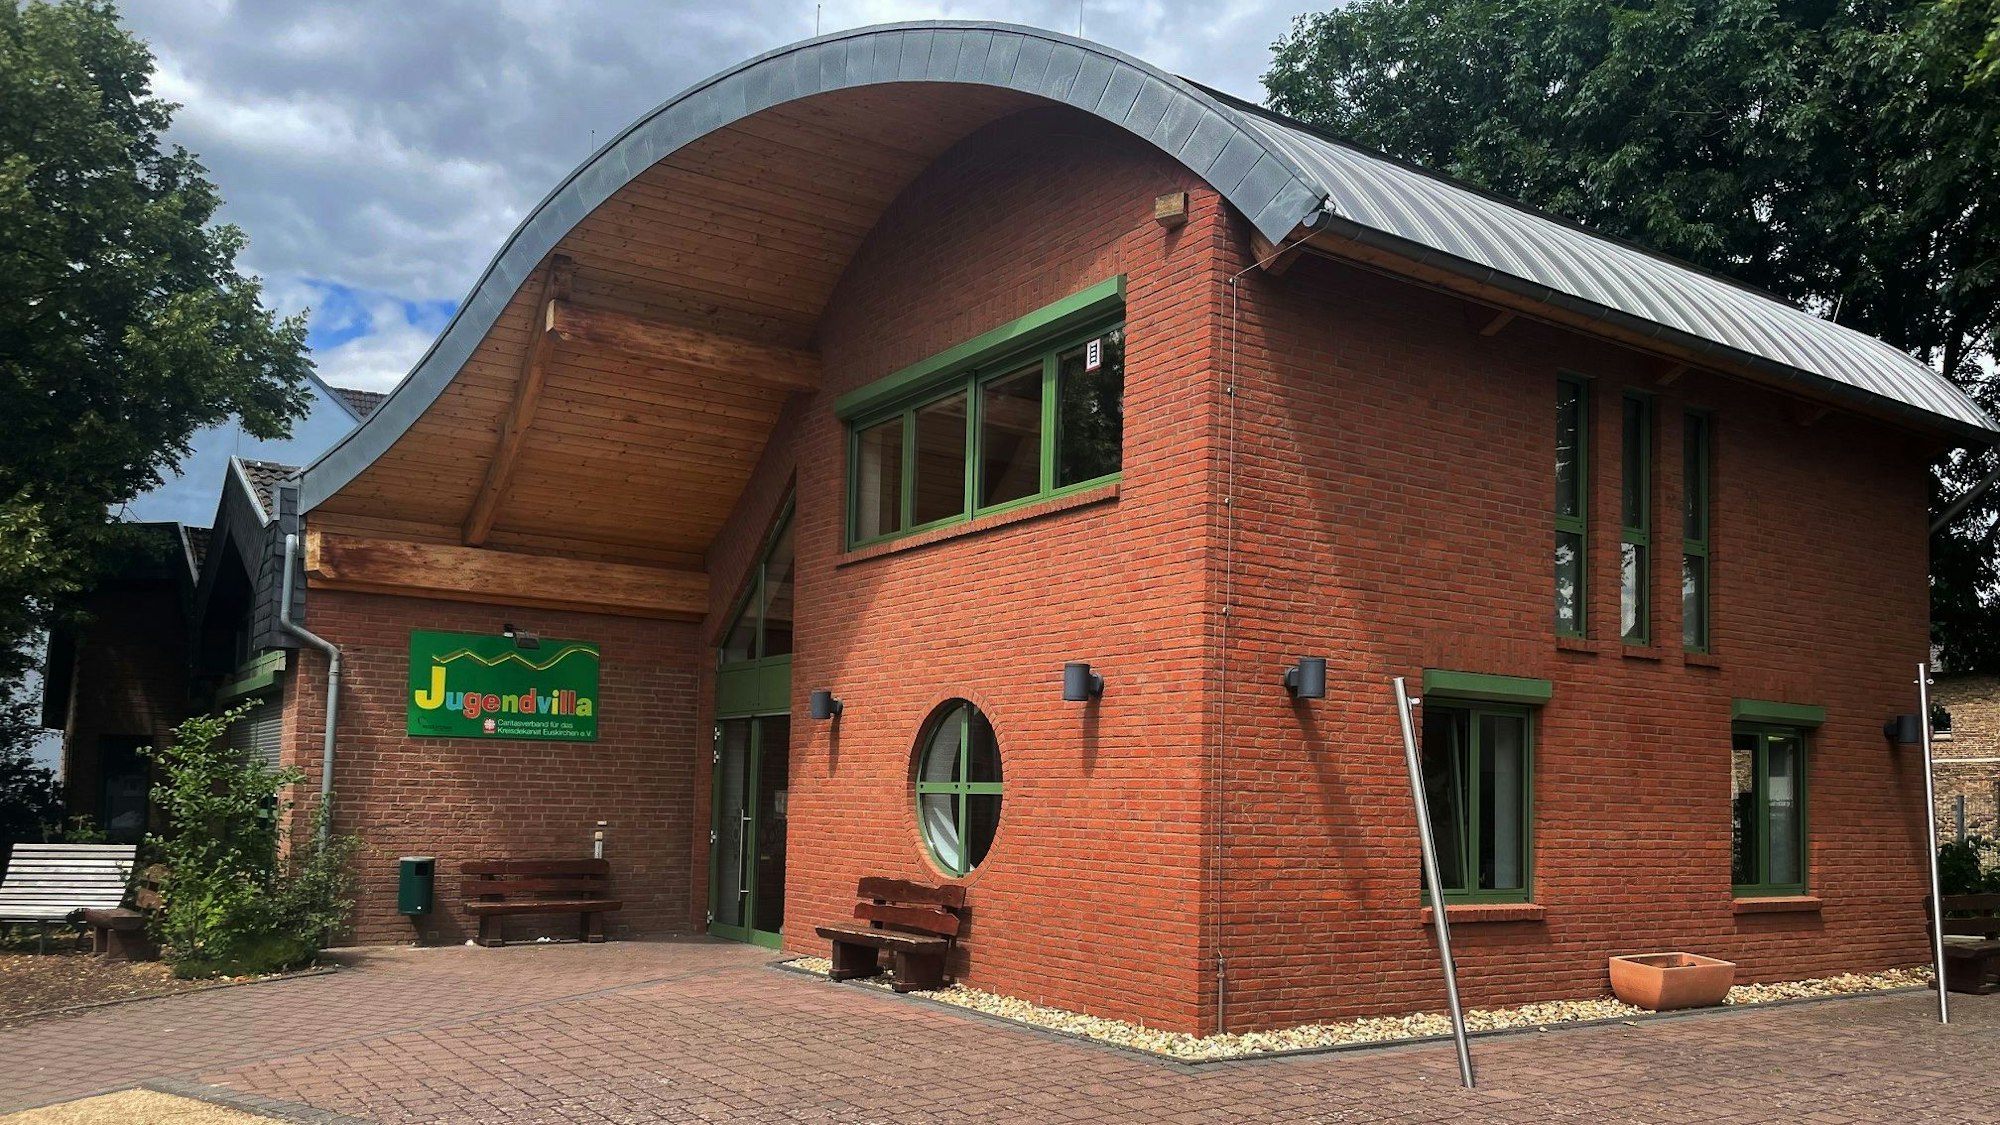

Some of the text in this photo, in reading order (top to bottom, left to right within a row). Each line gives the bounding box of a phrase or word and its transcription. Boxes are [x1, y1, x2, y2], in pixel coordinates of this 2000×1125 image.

[415, 666, 592, 718] Jugendvilla
[497, 718, 573, 729] Caritasverband für das
[497, 727, 541, 736] Kreisdekanat
[543, 728, 580, 737] Euskirchen
